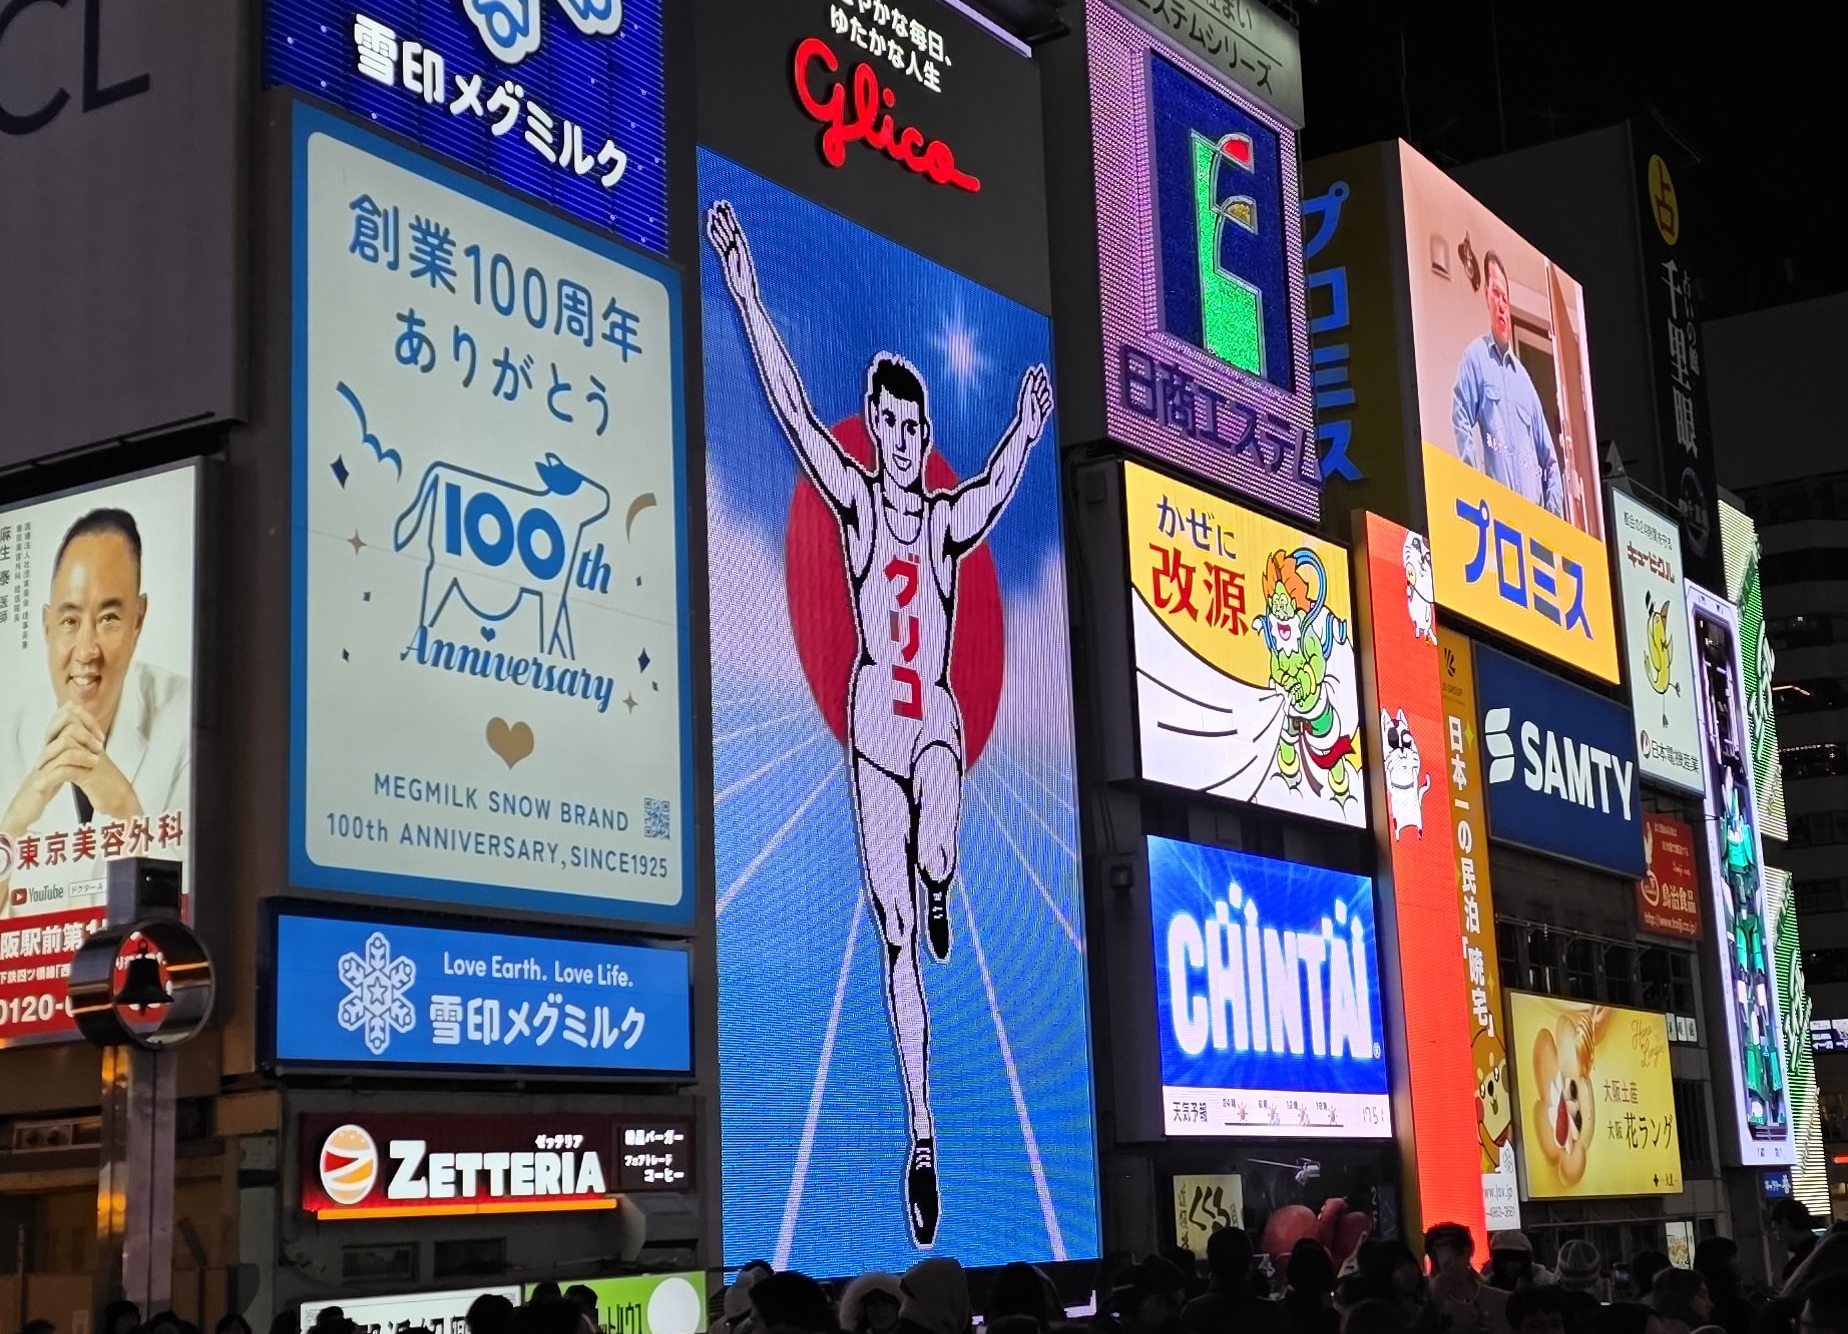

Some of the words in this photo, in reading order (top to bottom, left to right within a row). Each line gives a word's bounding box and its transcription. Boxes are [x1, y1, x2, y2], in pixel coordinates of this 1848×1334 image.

[829, 4, 942, 93] ゆたかな人生
[353, 12, 630, 189] 雪印メグミルク
[792, 36, 982, 193] Glico
[347, 193, 643, 364] 創業100周年
[394, 307, 610, 437] ありがとう
[1303, 180, 1364, 481] プロミス
[1119, 347, 1326, 487] 日商エステム
[1156, 494, 1237, 560] かぜに
[1456, 498, 1594, 641] プロミス
[1149, 542, 1249, 636] 改源
[400, 625, 614, 714] Anniversary
[885, 555, 923, 720] グリコ
[373, 772, 478, 810] MEGMILK
[488, 791, 551, 821] SNOW
[560, 803, 629, 832] BRAND
[1520, 720, 1634, 821] SAMTY
[16, 810, 184, 870] 東京美容外科
[326, 812, 389, 843] 100th
[28, 886, 64, 903] YouTube
[443, 952, 486, 976] Love
[492, 957, 547, 981] Earth.
[555, 960, 593, 984] Love
[598, 964, 633, 987] Life.
[1168, 897, 1373, 1060] CHINTAI
[429, 992, 646, 1050] 雪印メグミルク
[1604, 1081, 1639, 1104] 大阪土産
[1608, 1120, 1624, 1140] 大阪
[1624, 1112, 1673, 1149] 花ラング
[387, 1139, 606, 1200] ZETTERIA
[644, 1167, 685, 1183] コーヒー
